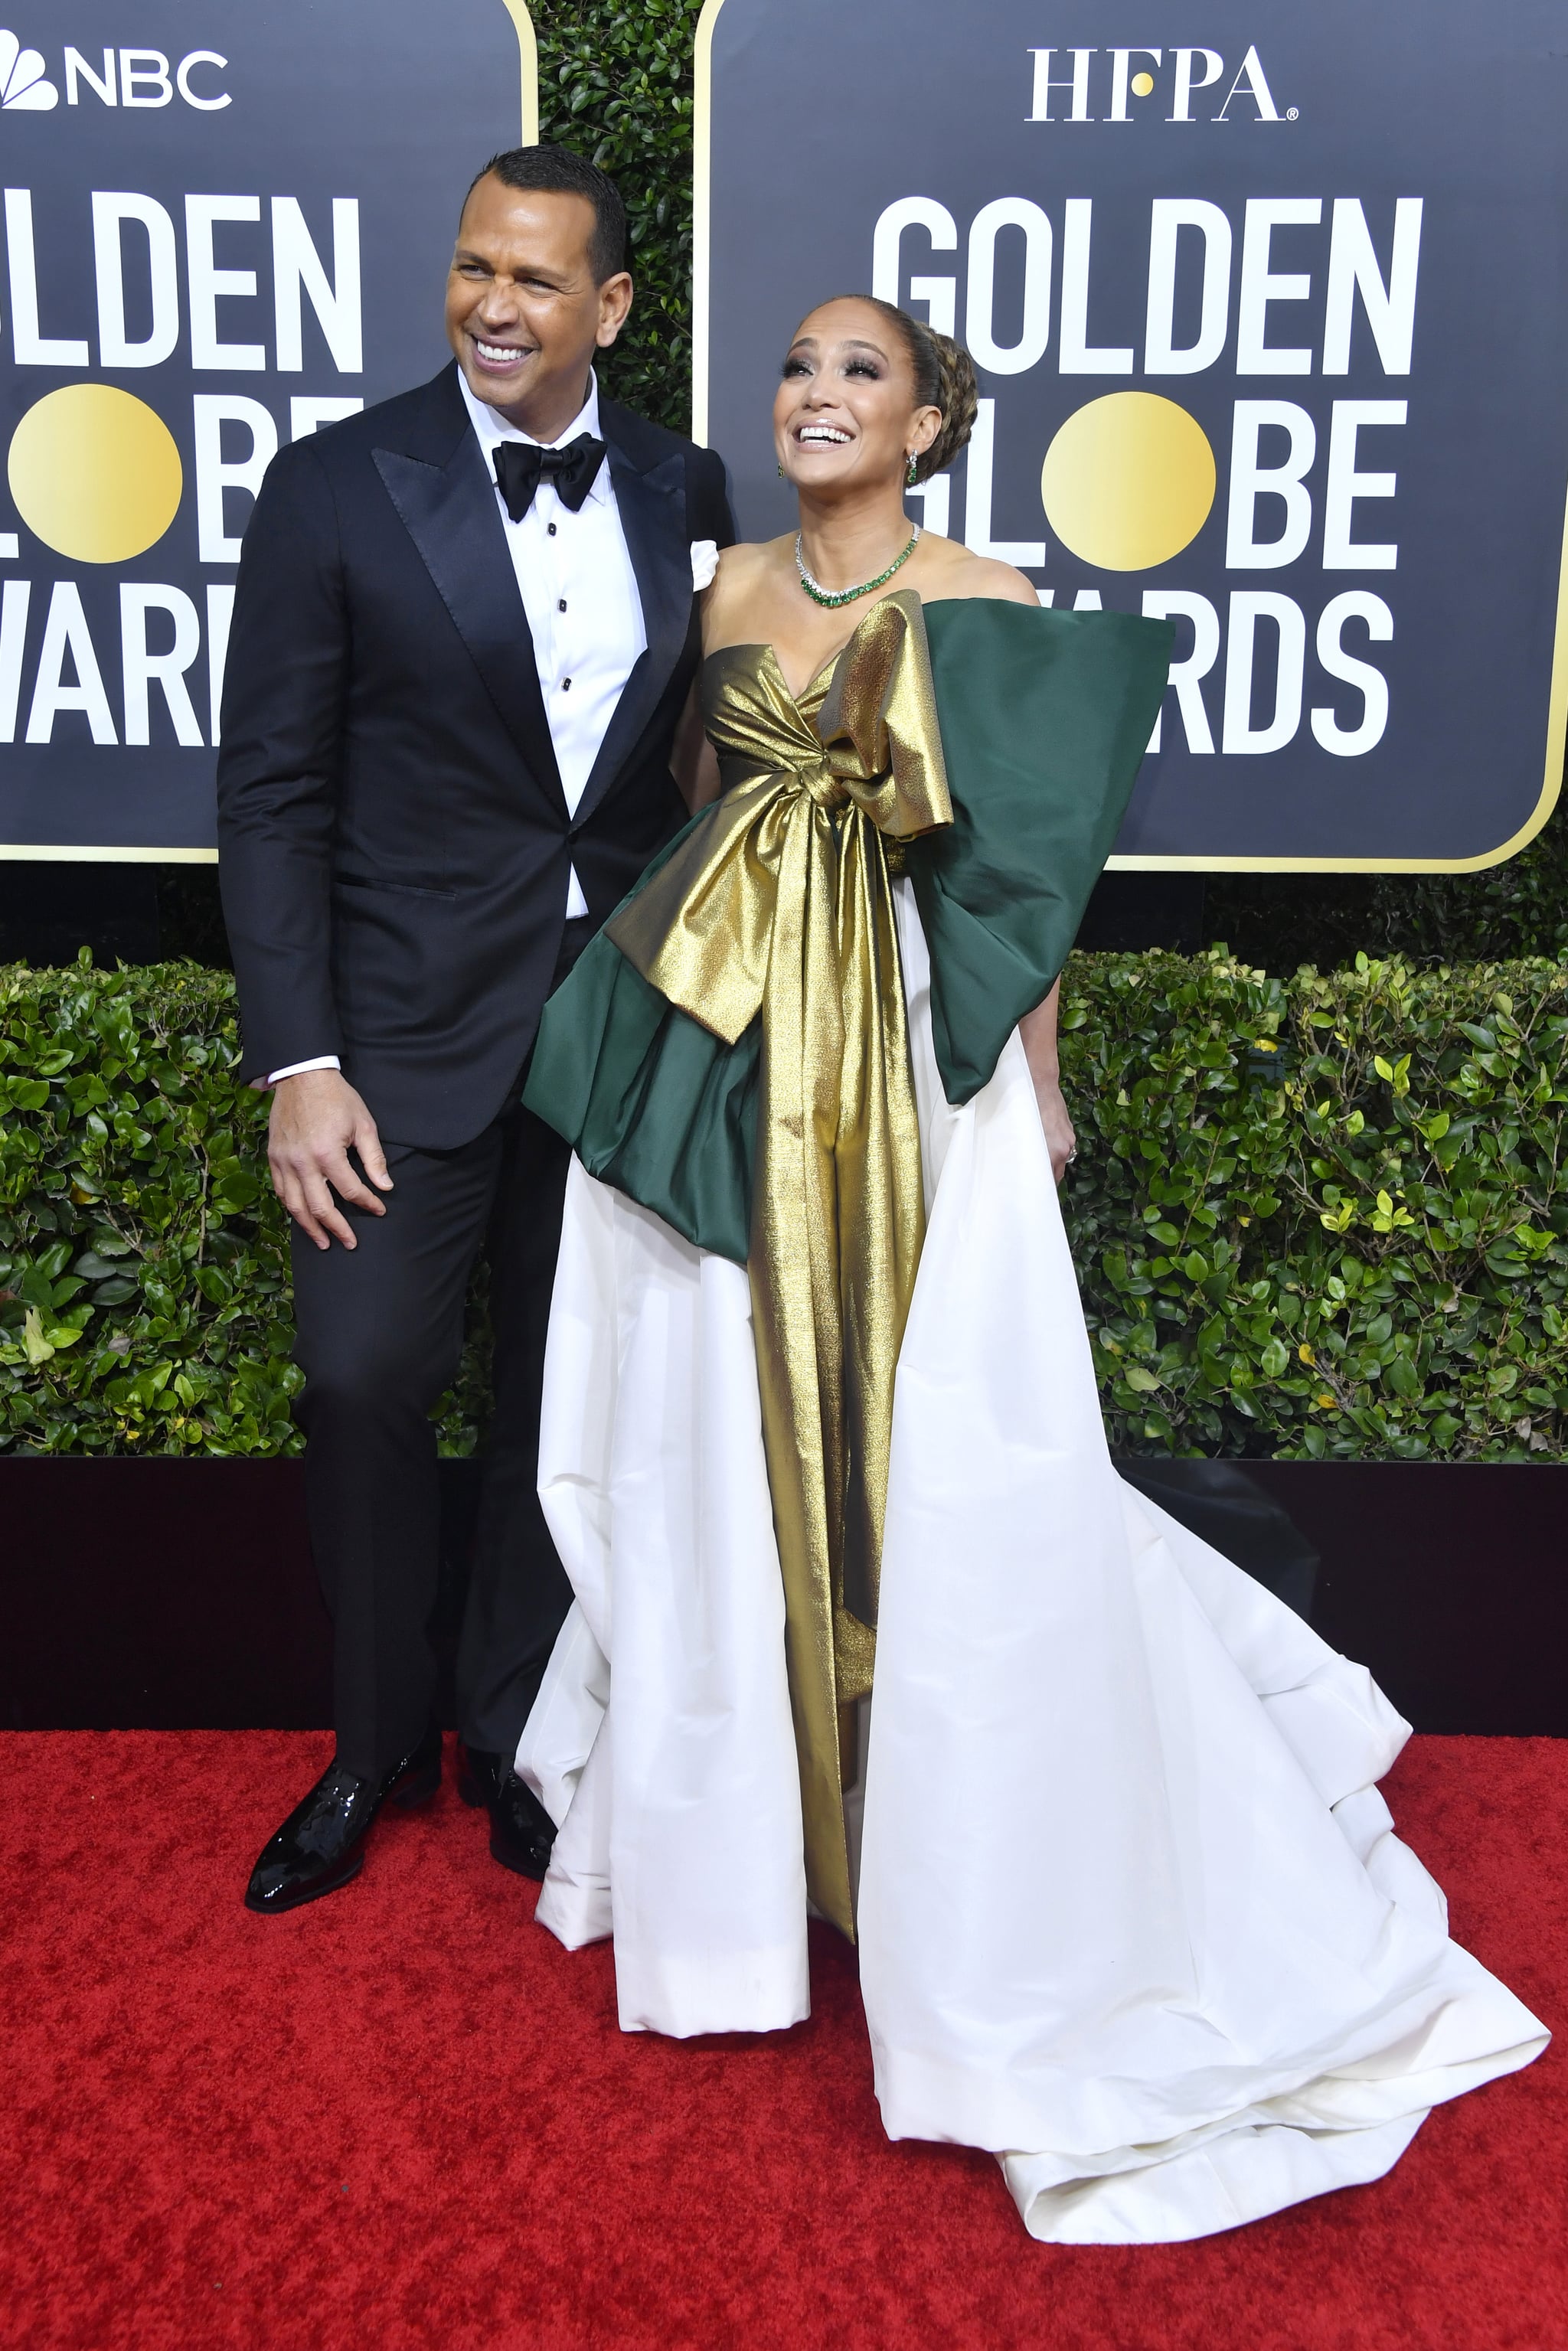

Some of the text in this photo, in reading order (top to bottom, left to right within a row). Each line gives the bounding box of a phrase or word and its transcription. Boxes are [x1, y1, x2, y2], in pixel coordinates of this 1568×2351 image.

[64, 47, 233, 111] NBC
[0, 188, 363, 374] LDEN
[872, 196, 1423, 375] GOLDEN
[1035, 589, 1393, 756] RDS
